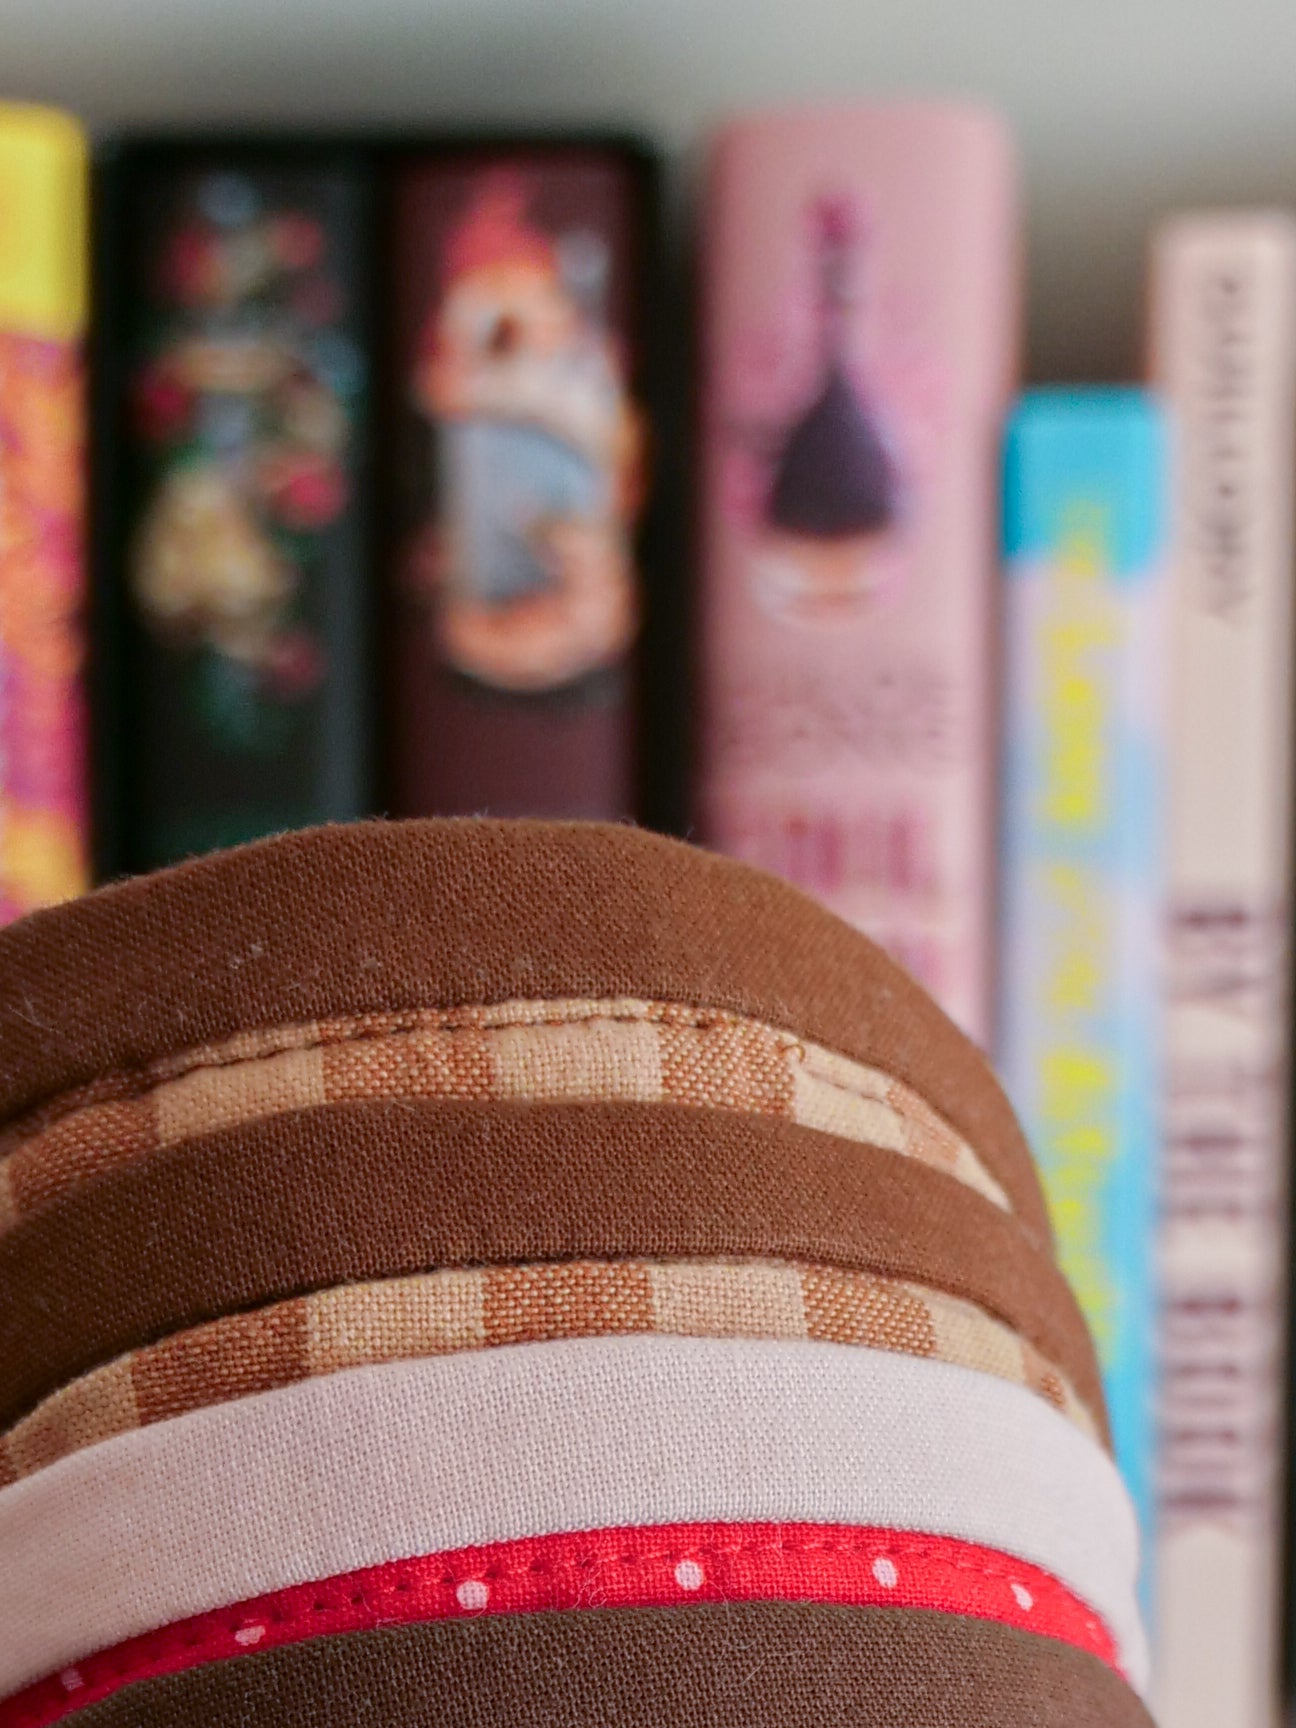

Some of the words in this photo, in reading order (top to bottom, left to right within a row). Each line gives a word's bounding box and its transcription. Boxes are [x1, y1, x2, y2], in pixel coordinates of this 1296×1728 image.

[1162, 889, 1292, 1029] BY
[1160, 1044, 1289, 1269] THE
[1156, 1288, 1286, 1540] BOOK
